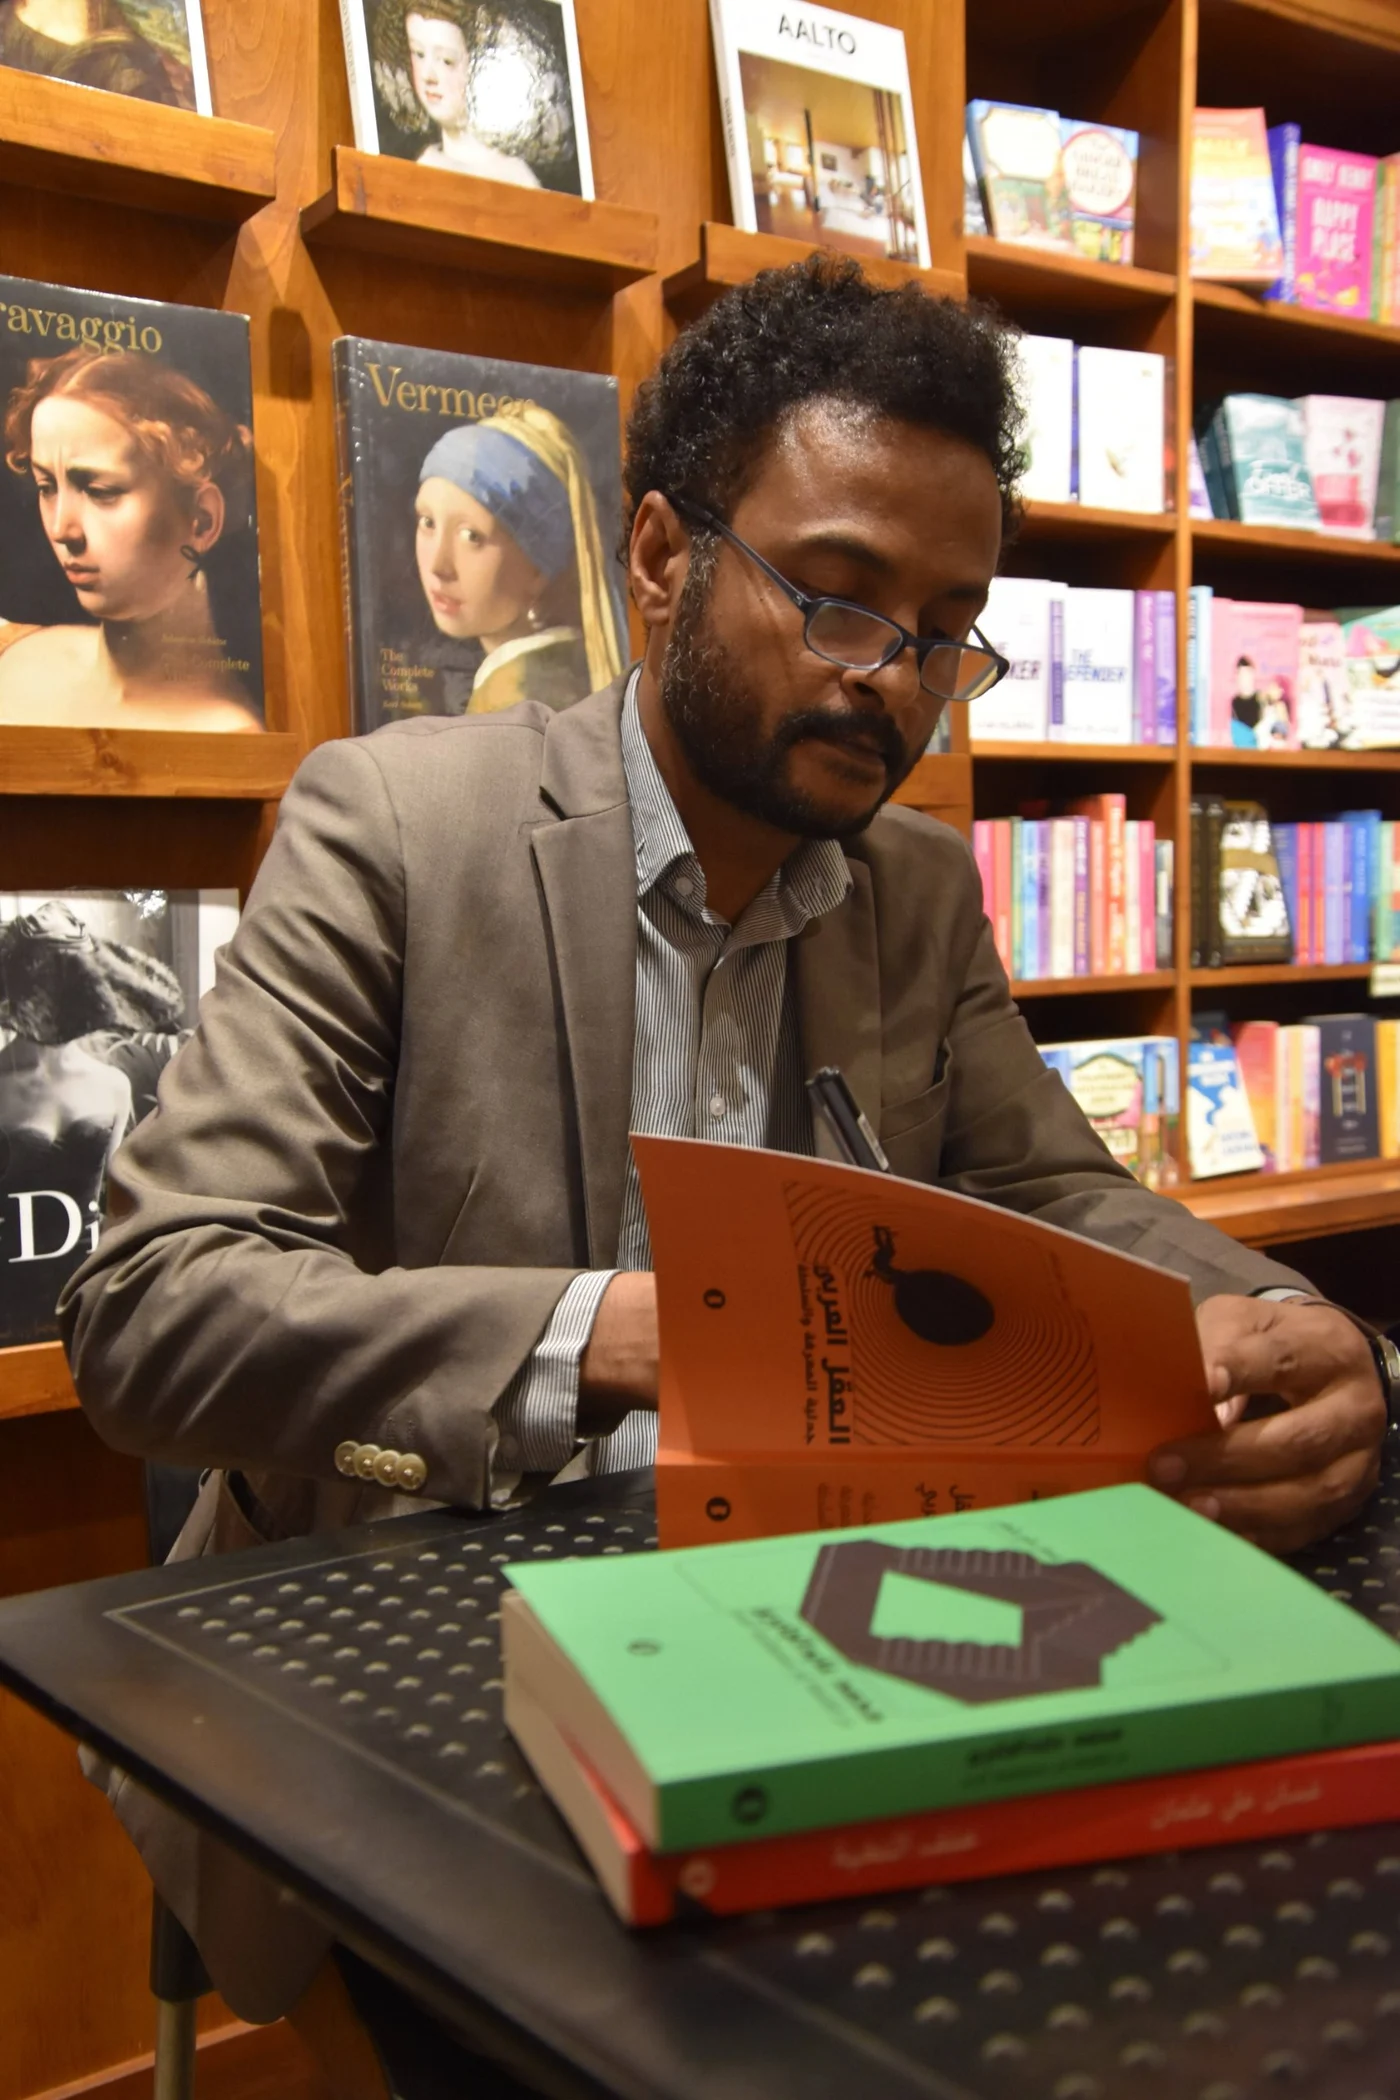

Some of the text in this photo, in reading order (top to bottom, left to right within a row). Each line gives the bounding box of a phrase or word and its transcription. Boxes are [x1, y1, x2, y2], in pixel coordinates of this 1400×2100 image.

[778, 12, 857, 55] AALTO
[365, 362, 538, 419] Vermeer
[821, 1358, 852, 1445] العقل
